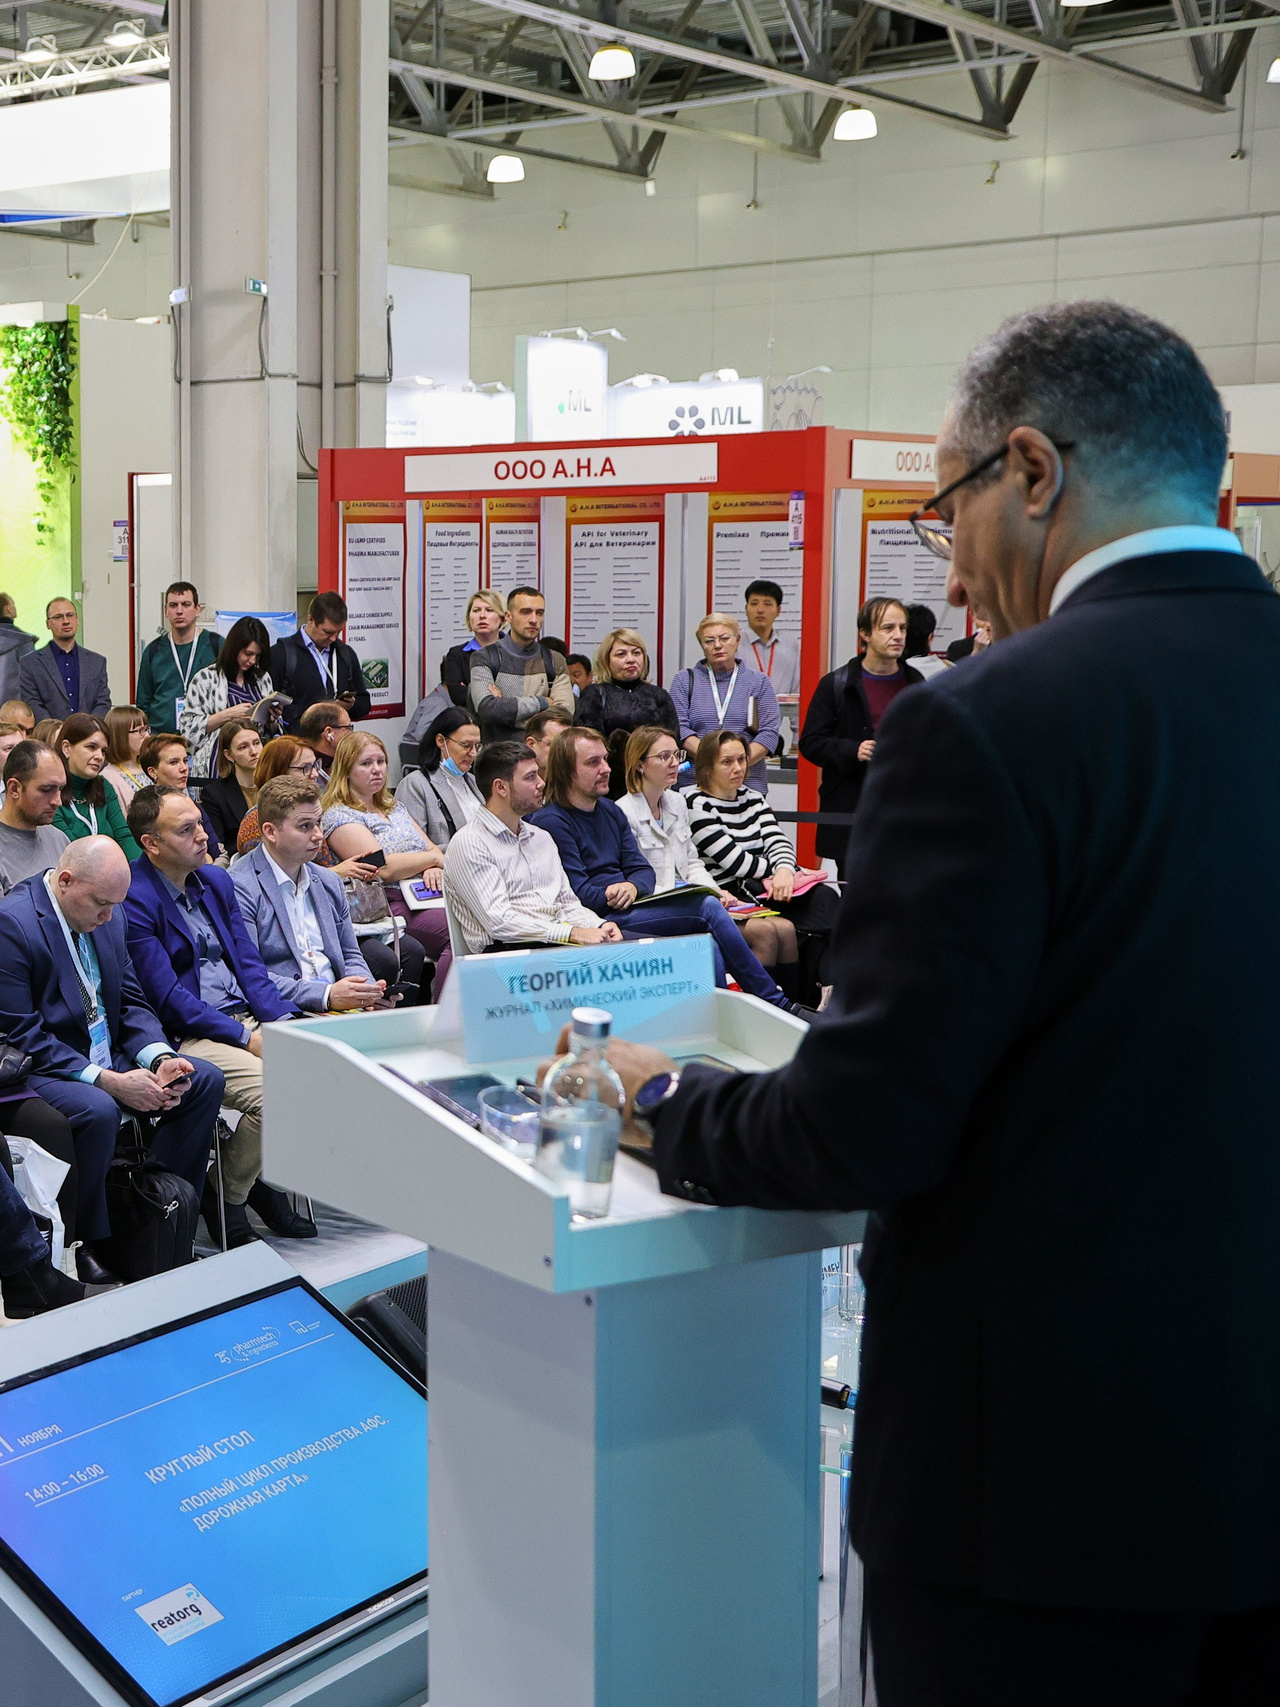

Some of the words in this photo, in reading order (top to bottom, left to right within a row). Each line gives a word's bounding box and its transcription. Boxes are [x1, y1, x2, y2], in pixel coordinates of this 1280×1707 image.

[568, 390, 591, 412] ML
[711, 406, 752, 426] ML
[118, 536, 129, 544] 311
[509, 963, 593, 994] ГЕОРГИЙ
[598, 956, 674, 982] ХАЧИЯН
[485, 1003, 543, 1020] ЖУРНАЛ
[640, 980, 699, 999] ЭКСПЕРТ»
[232, 1331, 276, 1353] pharmtech
[17, 1424, 63, 1448] НОЯБРЯ
[144, 1444, 218, 1484] КРУГЛЫЙ
[214, 1430, 256, 1455] СТОЛ
[179, 1478, 240, 1513] «ПОЛНЫЙ
[235, 1463, 275, 1487] ЦИКЛ
[270, 1425, 363, 1472] ПРОИЗВОДСТВА
[360, 1414, 390, 1433] АФС.
[24, 1481, 61, 1502] 14:00
[69, 1464, 105, 1484] 16:00
[192, 1490, 266, 1533] ДОРОЖНАЯ
[263, 1474, 309, 1499] КАРТА»
[151, 1603, 202, 1632] reatorg
